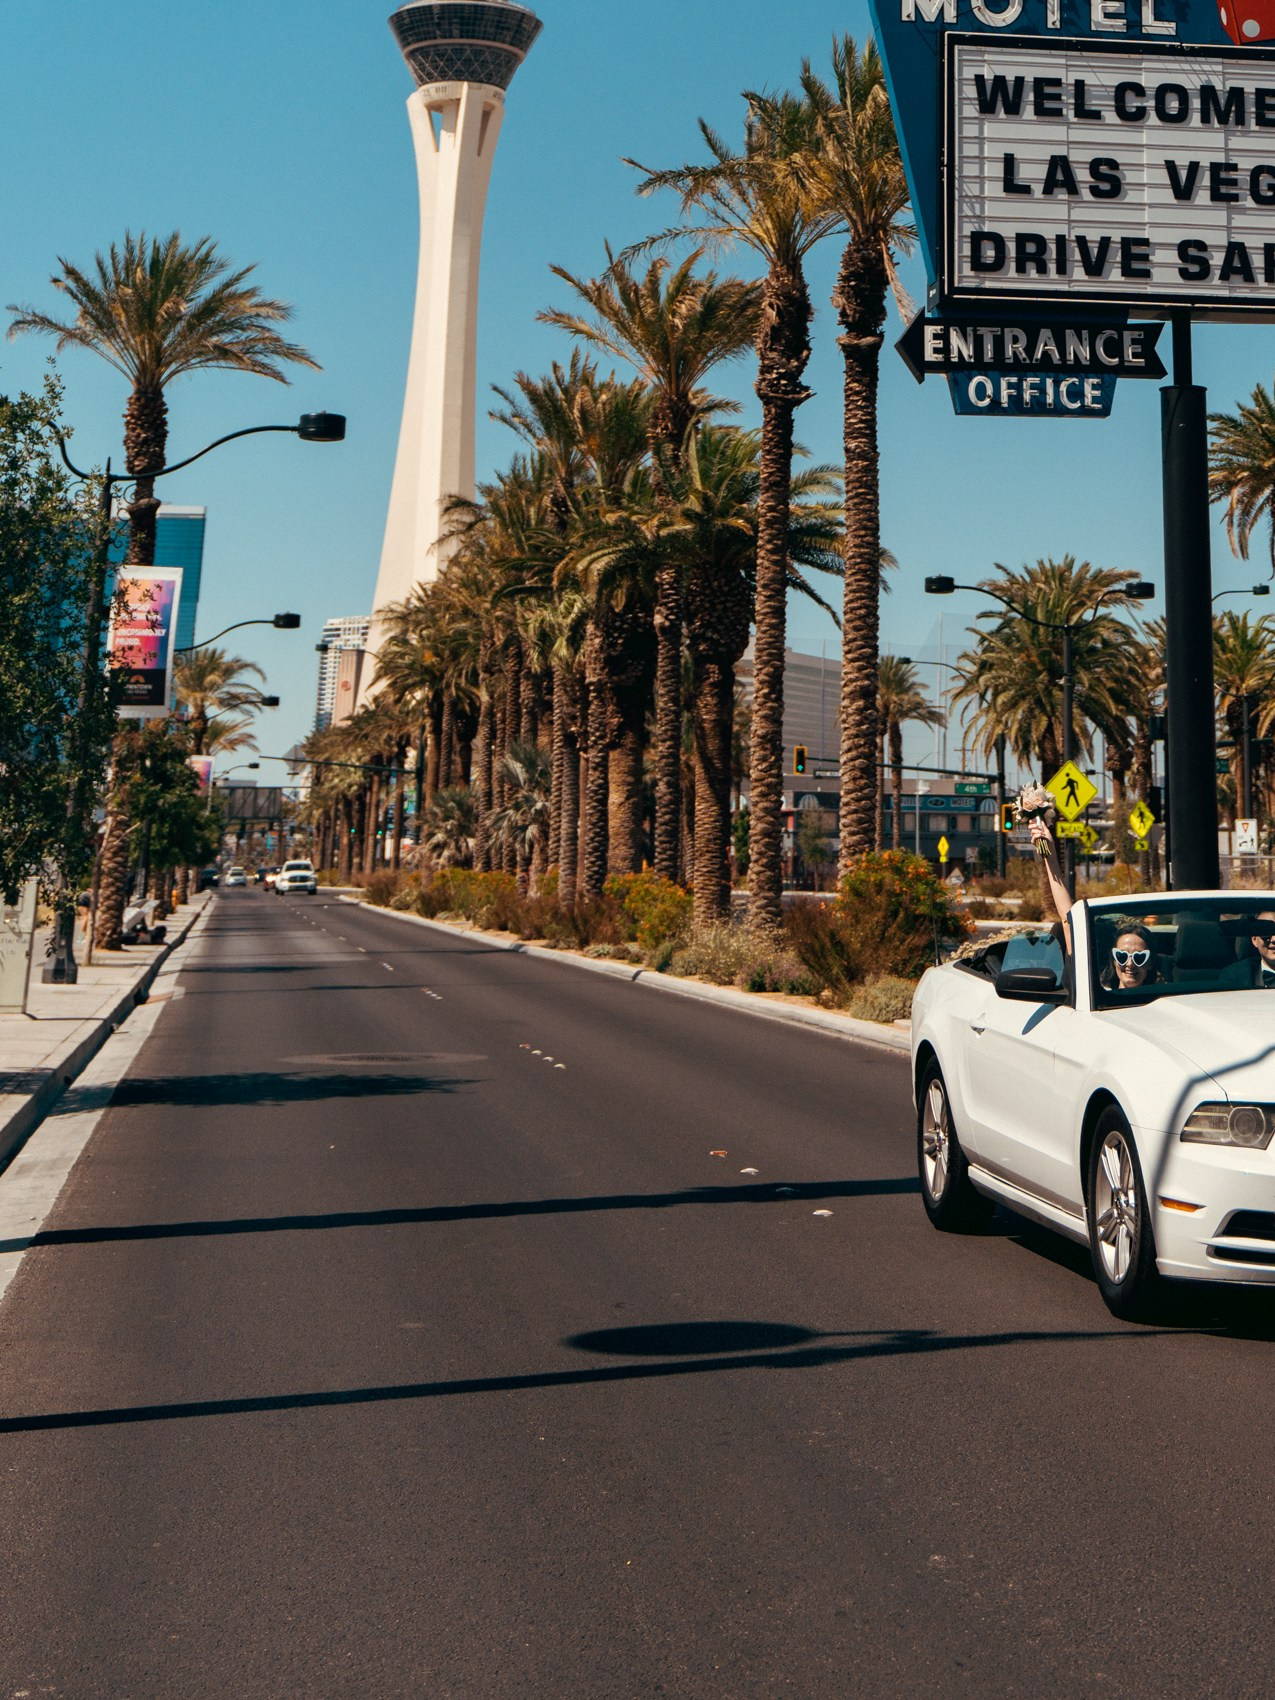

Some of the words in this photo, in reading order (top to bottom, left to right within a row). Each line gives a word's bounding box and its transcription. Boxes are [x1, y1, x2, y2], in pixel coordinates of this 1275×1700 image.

[1003, 152, 1122, 199] LAS
[970, 230, 1151, 278] DRIVE
[924, 325, 1146, 366] ENTRANCE
[968, 375, 1102, 410] OFFICE
[964, 785, 977, 793] 4th
